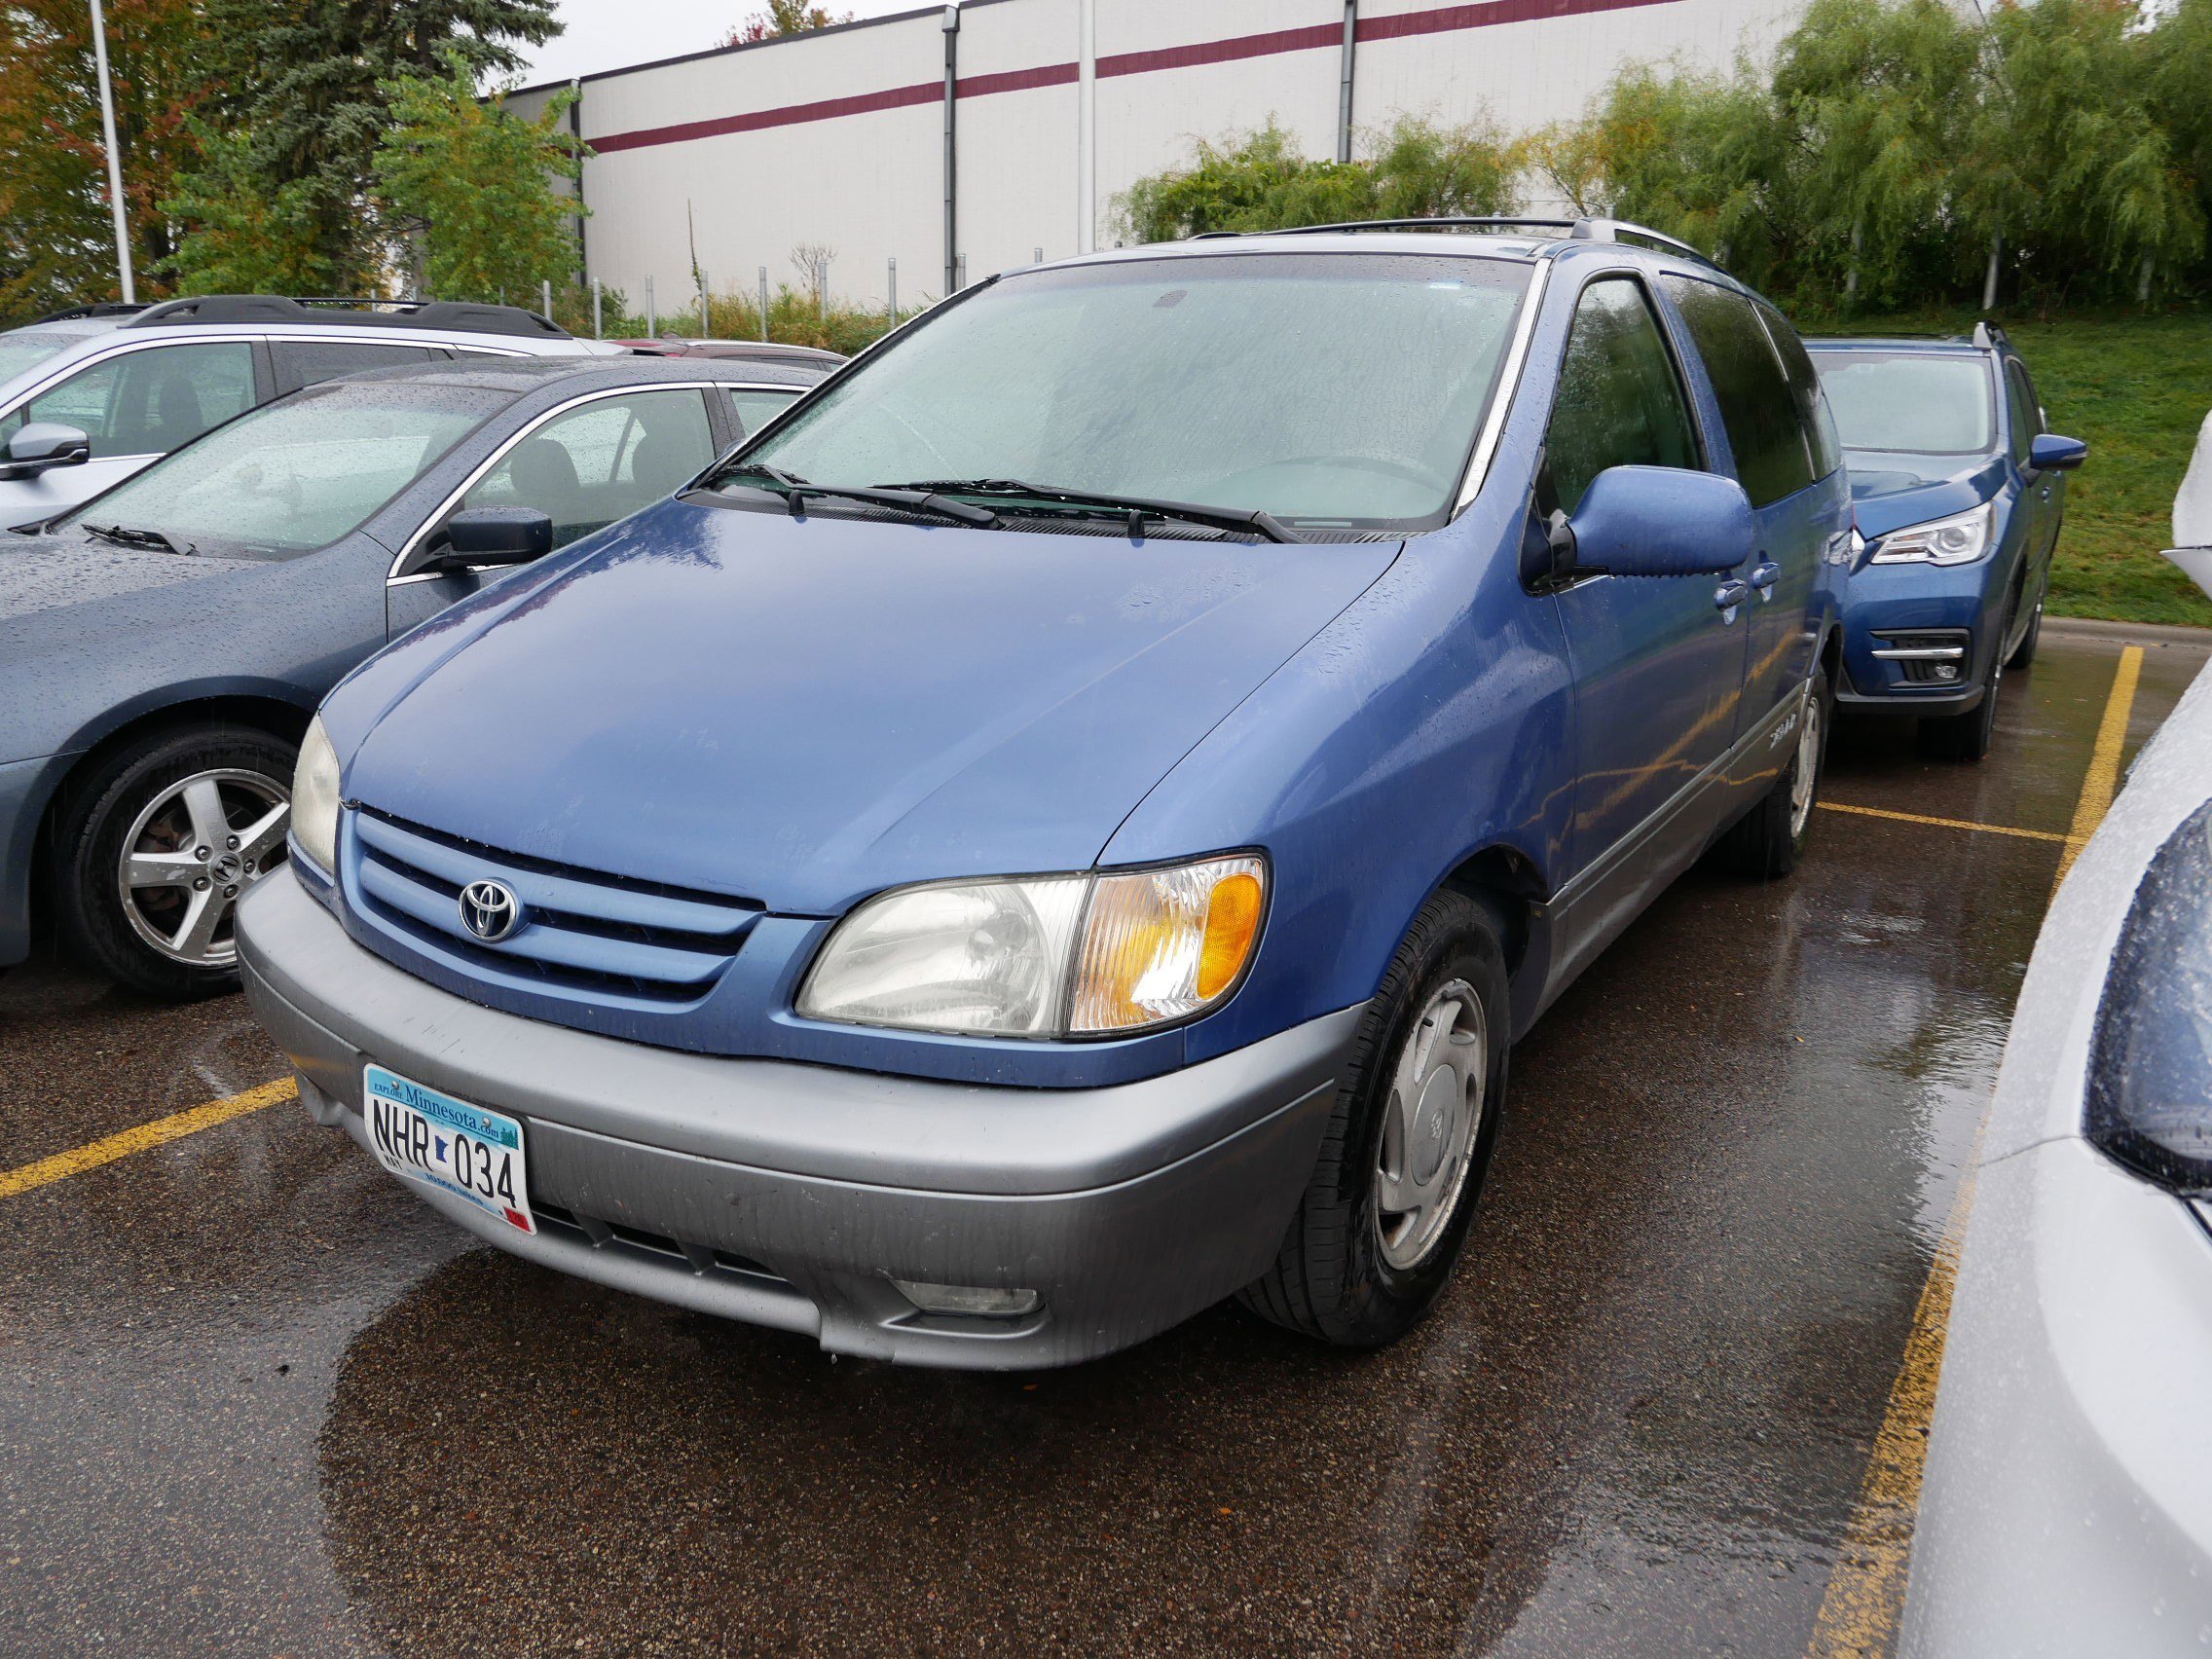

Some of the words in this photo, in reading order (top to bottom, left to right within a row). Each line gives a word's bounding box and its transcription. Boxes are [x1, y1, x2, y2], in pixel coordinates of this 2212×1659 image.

[374, 1083, 404, 1100] EXPLORE
[373, 1098, 434, 1172] NHR
[454, 1133, 517, 1208] 034
